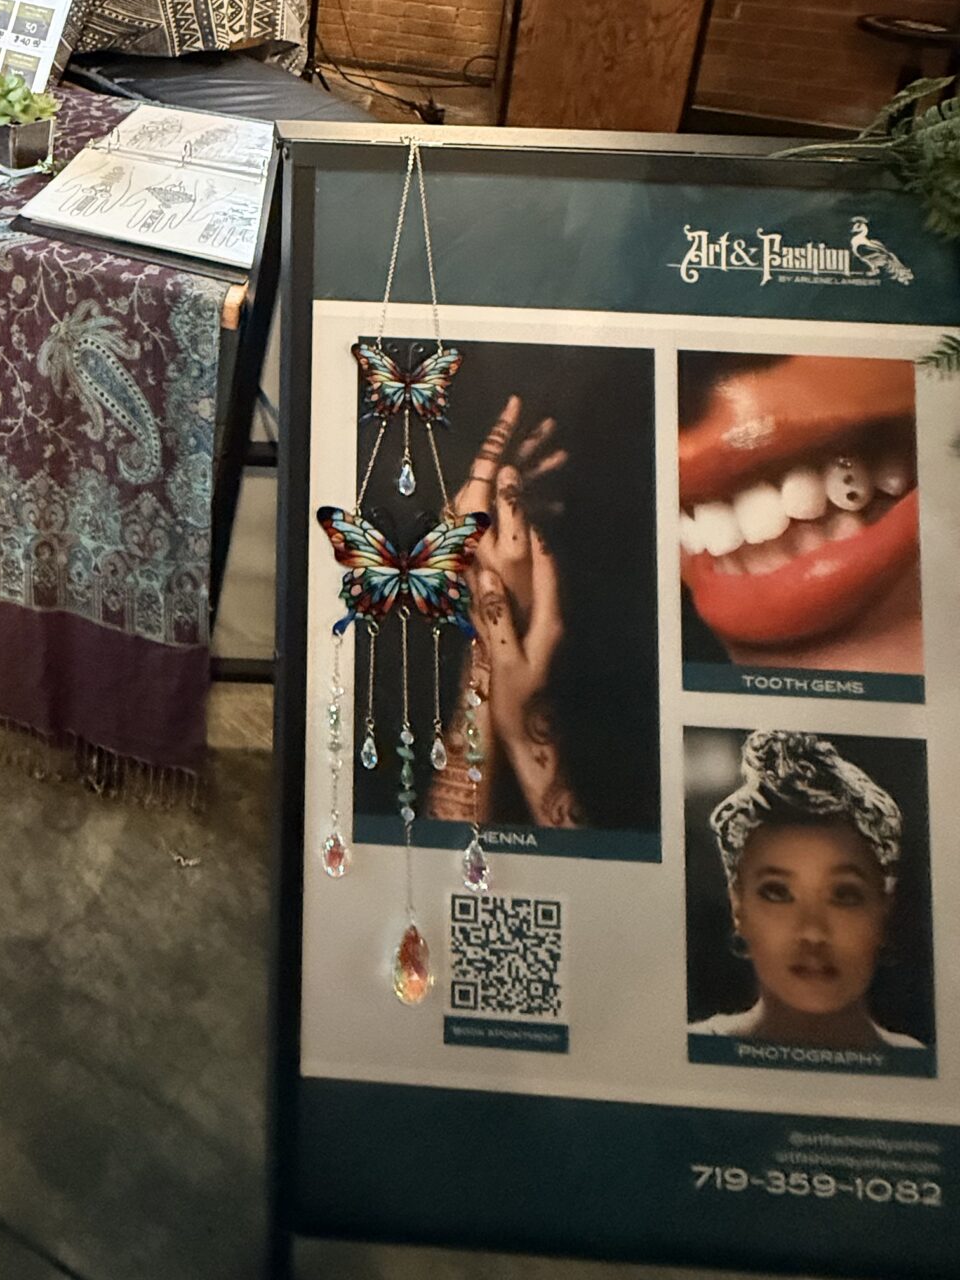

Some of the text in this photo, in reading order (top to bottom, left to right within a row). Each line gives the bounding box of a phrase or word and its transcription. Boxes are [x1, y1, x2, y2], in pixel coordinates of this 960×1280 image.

[680, 224, 730, 283] Art
[756, 227, 852, 287] Fashion
[741, 675, 865, 694] TOOTH GEMS
[478, 830, 538, 848] HENNA
[737, 1042, 884, 1067] PHOTOGRAPHY
[690, 1165, 942, 1207] 719-359-1082
